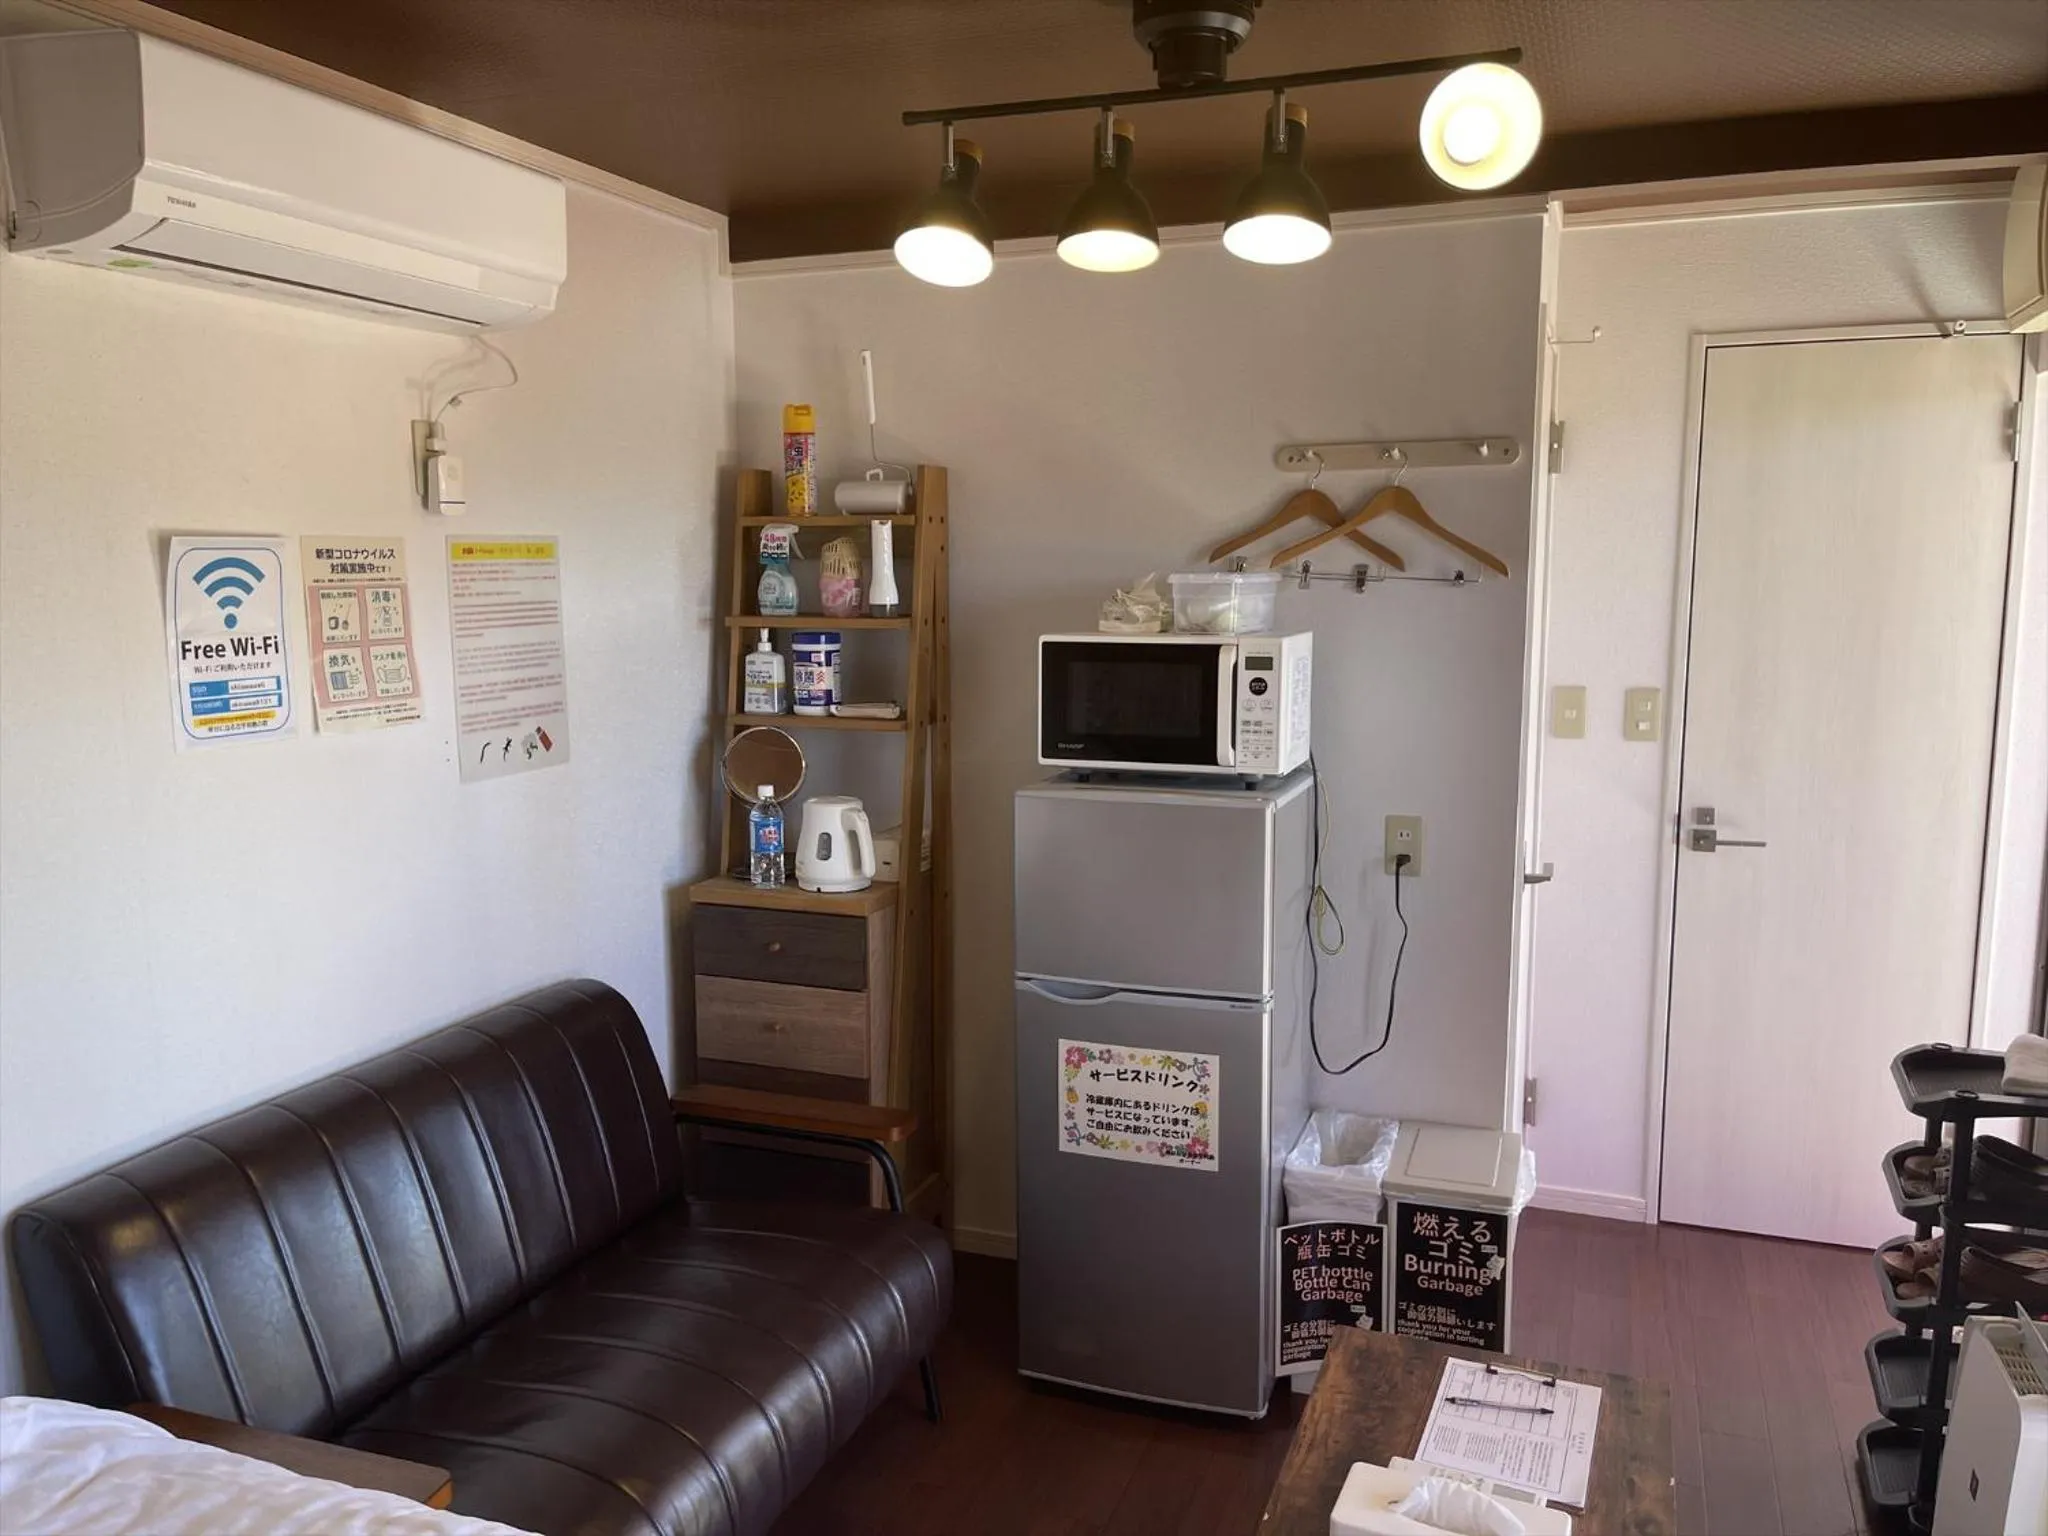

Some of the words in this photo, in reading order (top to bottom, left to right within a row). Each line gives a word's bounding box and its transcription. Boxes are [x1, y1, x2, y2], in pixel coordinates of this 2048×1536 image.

[315, 548, 396, 560] 新型コロナウイルス
[181, 640, 226, 660] Free
[230, 635, 279, 657] Wi-Fi
[1089, 1068, 1199, 1093] サービスドリンク
[1086, 1093, 1200, 1116] 冷蔵庫内にあるドリンクは
[1086, 1118, 1190, 1140] ご自由にお飲みください
[1284, 1228, 1380, 1245] ペットボトル
[1413, 1211, 1491, 1243] 燃える
[1429, 1238, 1475, 1264] ゴミ
[1292, 1266, 1318, 1281] PET
[1404, 1254, 1493, 1286] Burning
[1294, 1277, 1338, 1291] Bottle
[1342, 1277, 1371, 1291] Can
[1417, 1275, 1484, 1297] Garbage
[1301, 1288, 1364, 1303] Garbage
[1456, 1334, 1485, 1346] sorting
